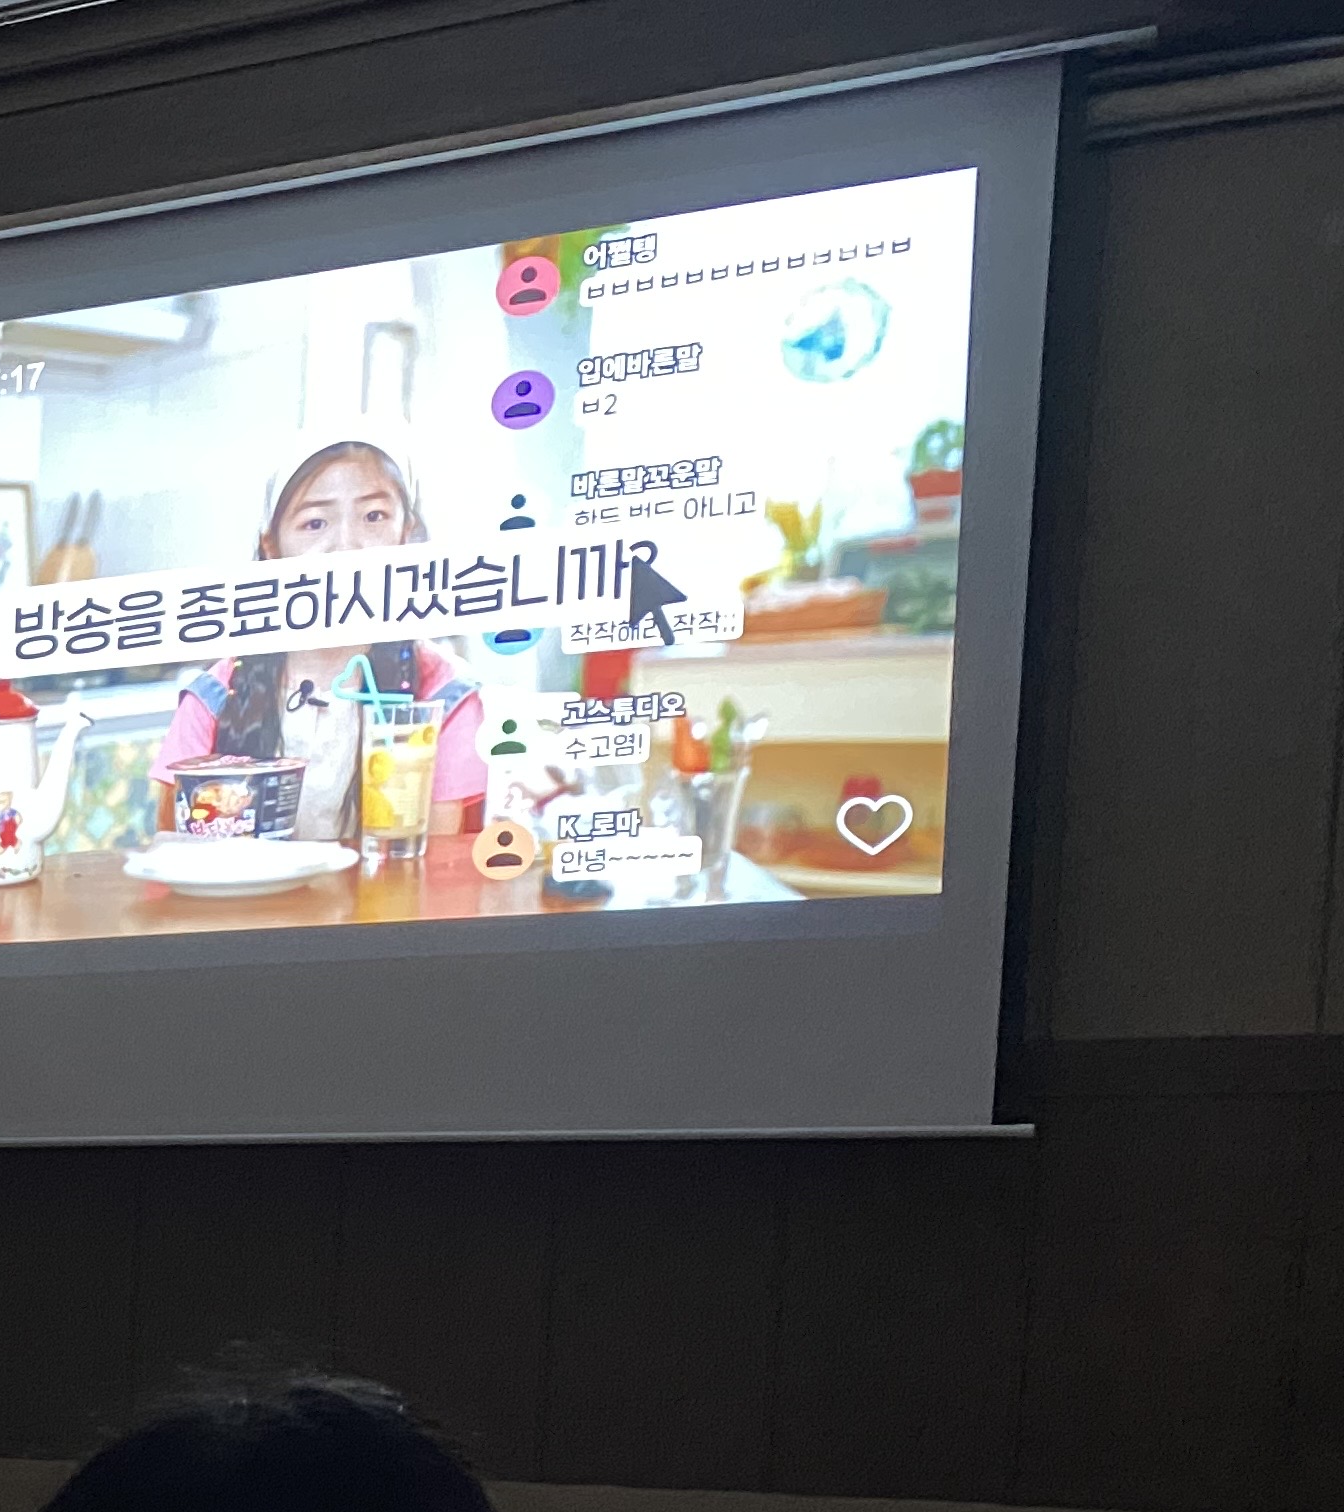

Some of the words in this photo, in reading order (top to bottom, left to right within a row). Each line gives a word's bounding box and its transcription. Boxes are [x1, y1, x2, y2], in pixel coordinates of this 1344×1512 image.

[577, 342, 703, 387] 입에바른말
[683, 491, 757, 520] 아니고
[14, 590, 166, 660] 방송을
[176, 538, 659, 643] 종료하시겠습니까?
[561, 692, 686, 726] 고스튜디오
[564, 732, 644, 760] 수고염!
